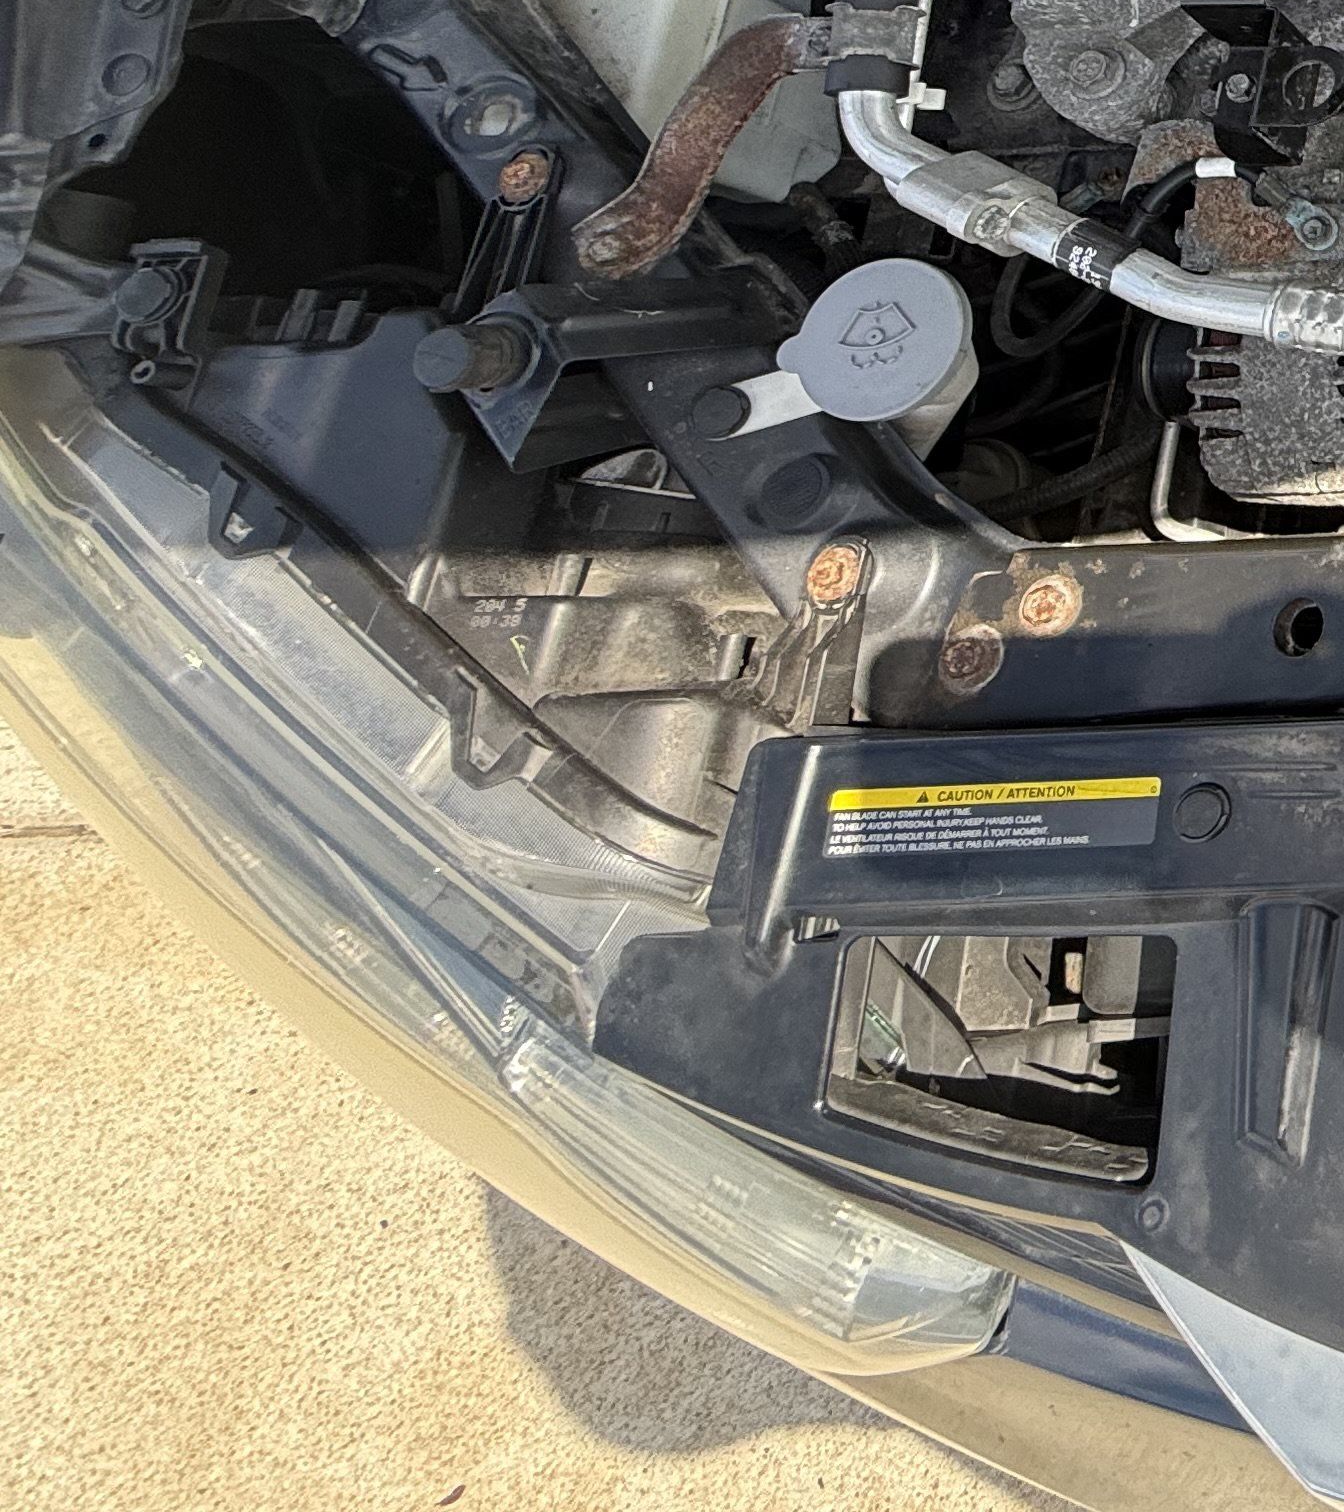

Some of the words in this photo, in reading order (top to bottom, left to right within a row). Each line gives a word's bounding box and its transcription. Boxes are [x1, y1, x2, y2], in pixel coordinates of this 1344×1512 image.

[937, 789, 993, 802] CAUTION
[996, 789, 1004, 800] /
[1006, 785, 1075, 799] ATTENTION
[834, 812, 851, 821] FAN
[851, 811, 878, 820] BLADE
[878, 811, 897, 820] CAN
[898, 810, 922, 819] START
[923, 809, 934, 818] AT
[934, 808, 952, 817] ANY
[832, 822, 845, 832] TO
[845, 821, 867, 832] HELP
[866, 821, 892, 831] AVOID
[892, 820, 934, 830] PERSONAL
[985, 816, 1014, 825] HANDS
[829, 834, 842, 844] LE
[842, 833, 893, 843] VENTILATEUR
[894, 831, 925, 841] RISQUE
[925, 831, 937, 840] DE
[938, 829, 982, 839] DÉMARRER
[983, 827, 990, 837] À
[990, 828, 1011, 837] TOUT
[827, 845, 852, 855] POUR
[881, 843, 907, 852] TOUTE
[953, 840, 964, 849] NE
[965, 839, 982, 848] PAS
[983, 839, 995, 848] EN
[995, 837, 1046, 847] APPROCHER
[1047, 836, 1062, 845] LES
